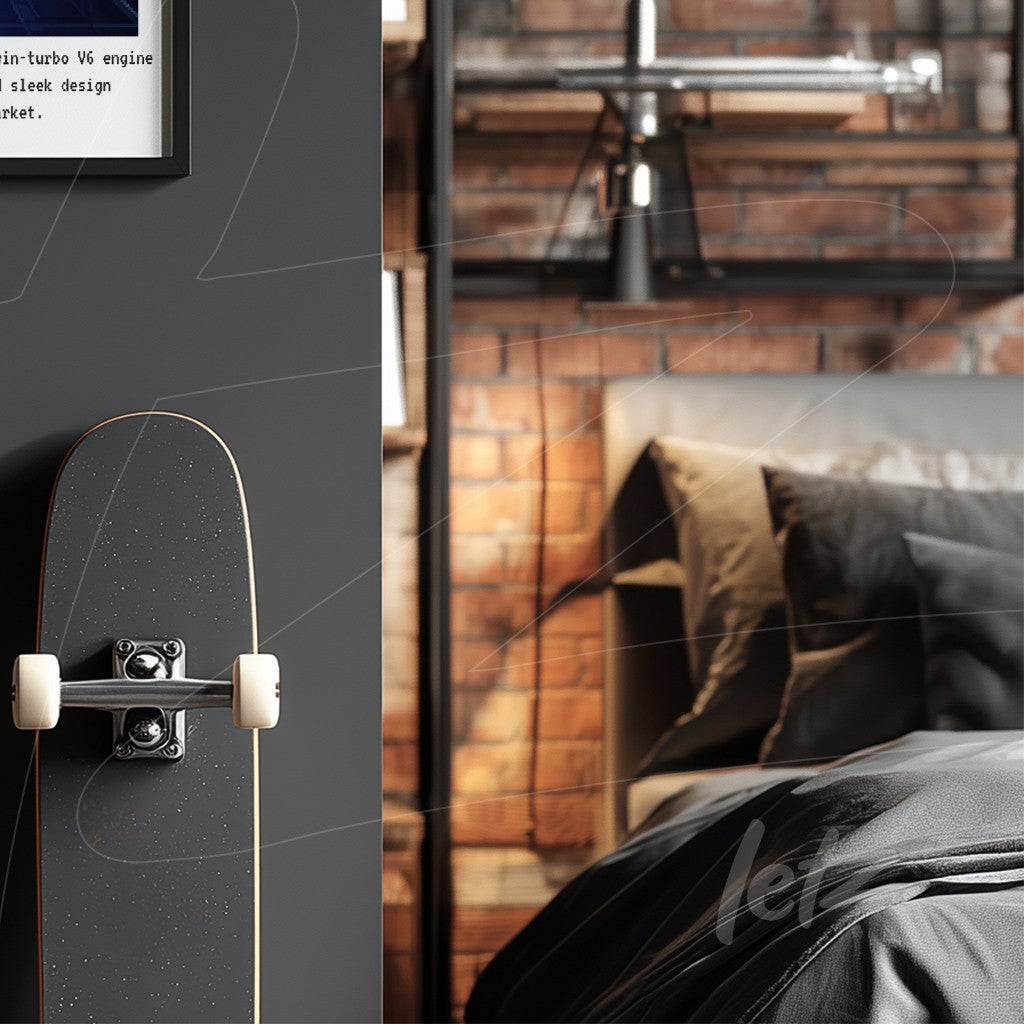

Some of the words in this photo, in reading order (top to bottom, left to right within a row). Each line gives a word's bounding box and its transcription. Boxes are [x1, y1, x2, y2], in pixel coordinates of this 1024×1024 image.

[77, 50, 94, 65] V6
[102, 50, 153, 68] engine
[10, 78, 53, 92] sleek
[61, 78, 111, 96] design
